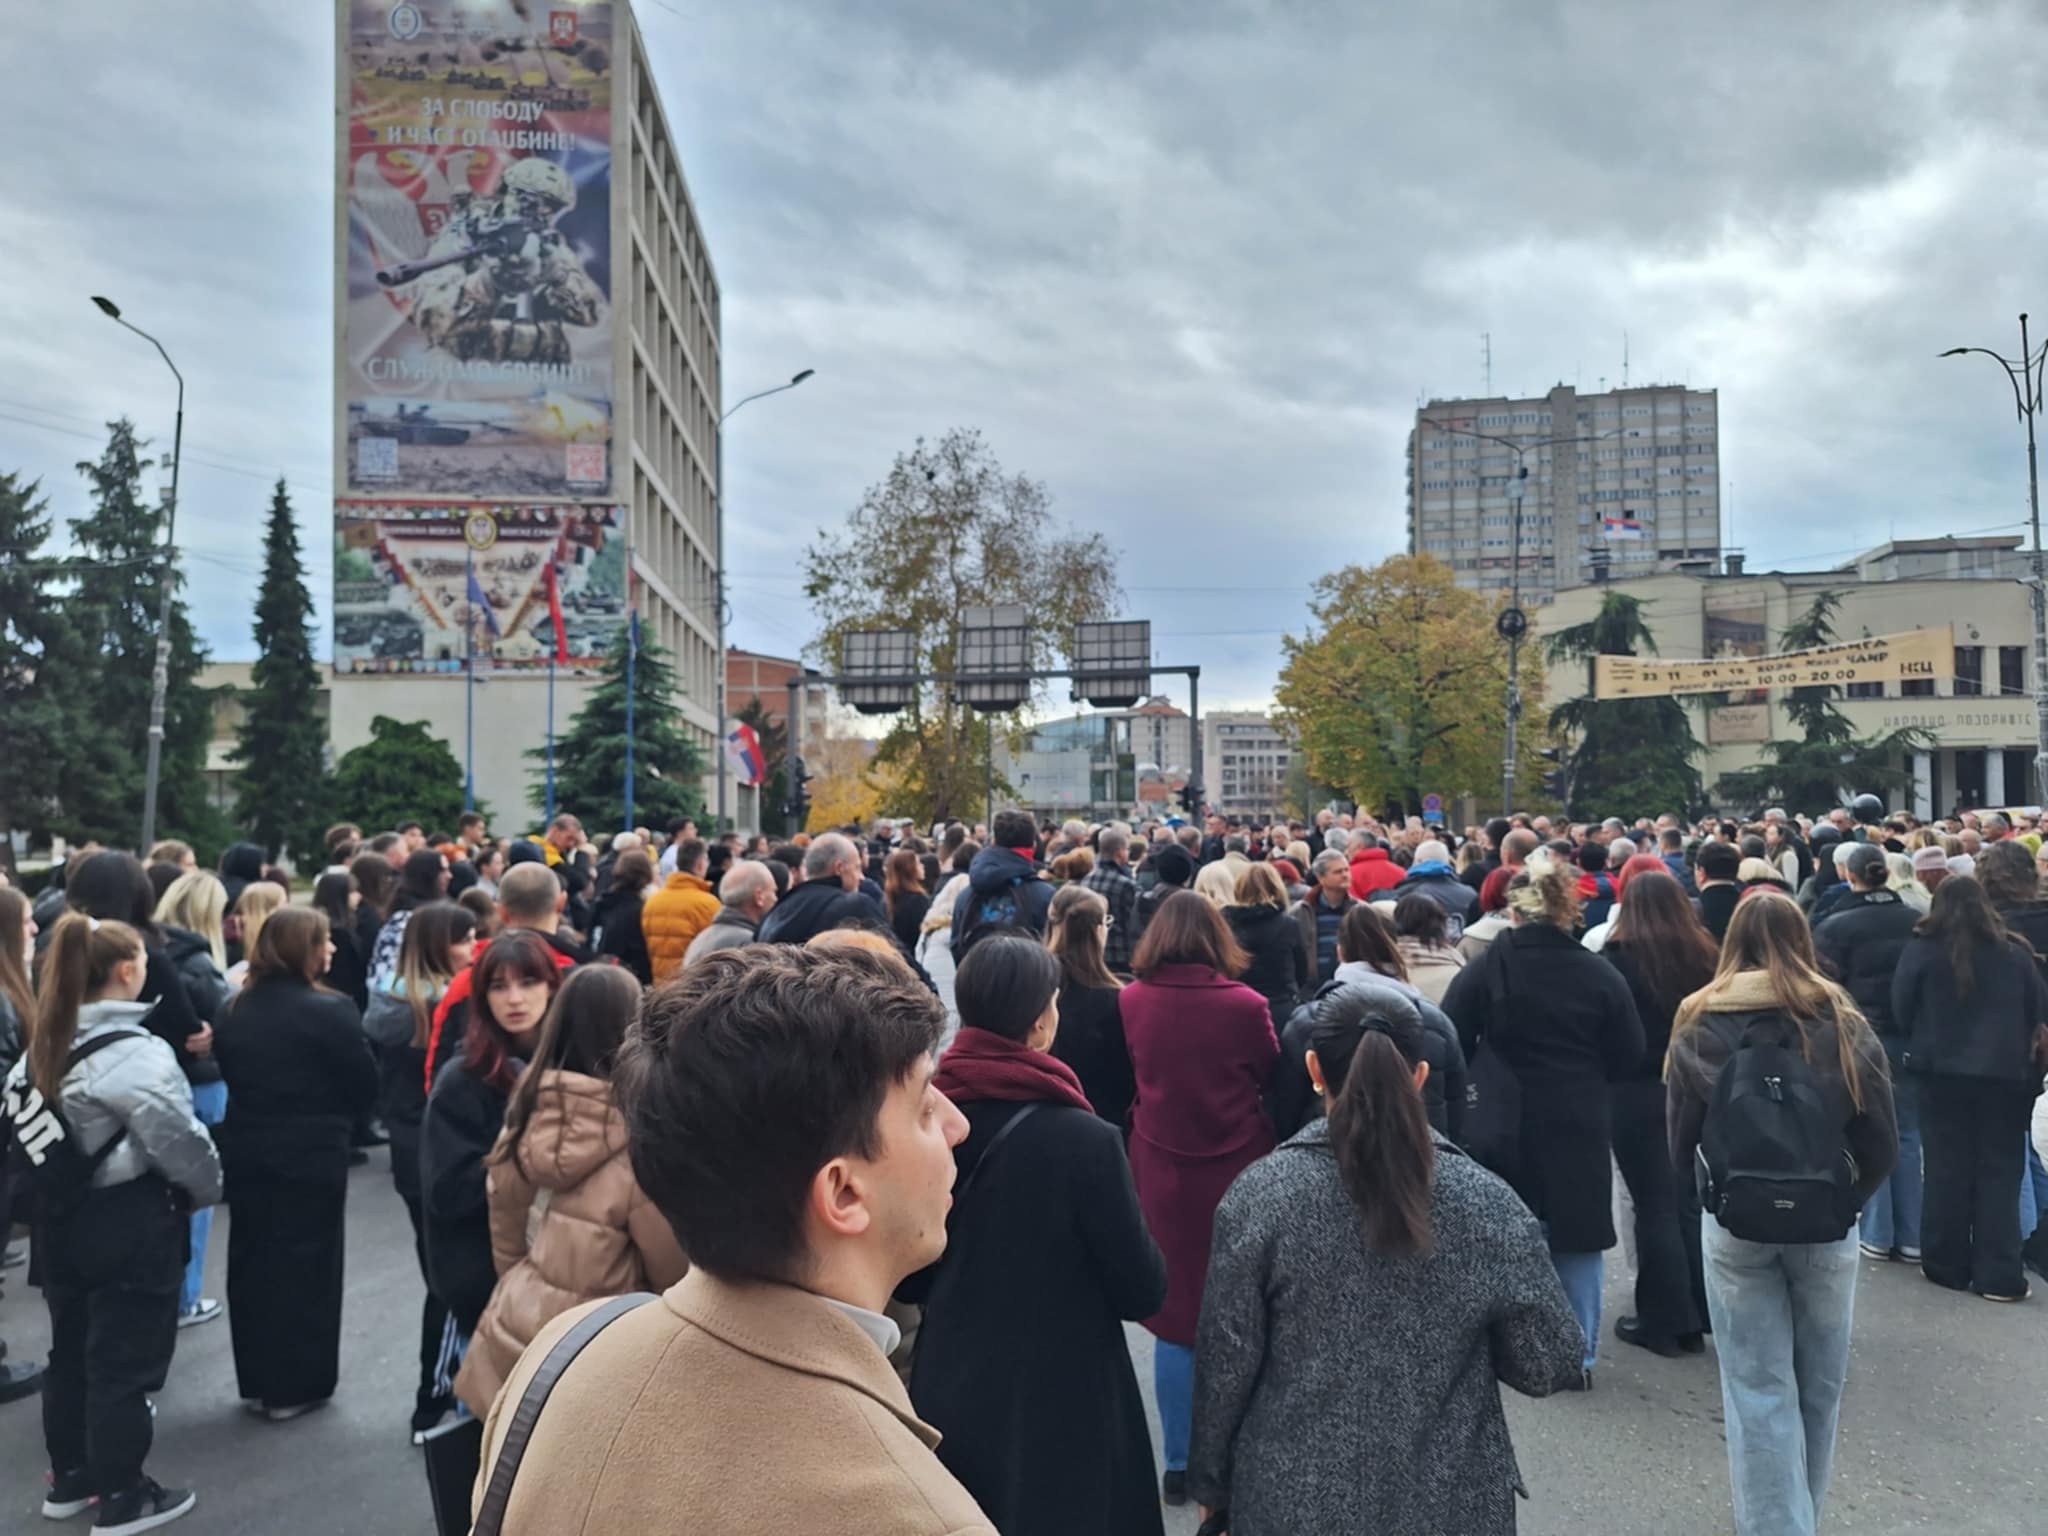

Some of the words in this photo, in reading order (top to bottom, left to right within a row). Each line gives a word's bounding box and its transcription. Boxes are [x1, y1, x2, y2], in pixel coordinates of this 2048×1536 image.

[421, 97, 444, 117] ЗА
[451, 99, 544, 122] СЛОБОДУ
[388, 126, 401, 143] И
